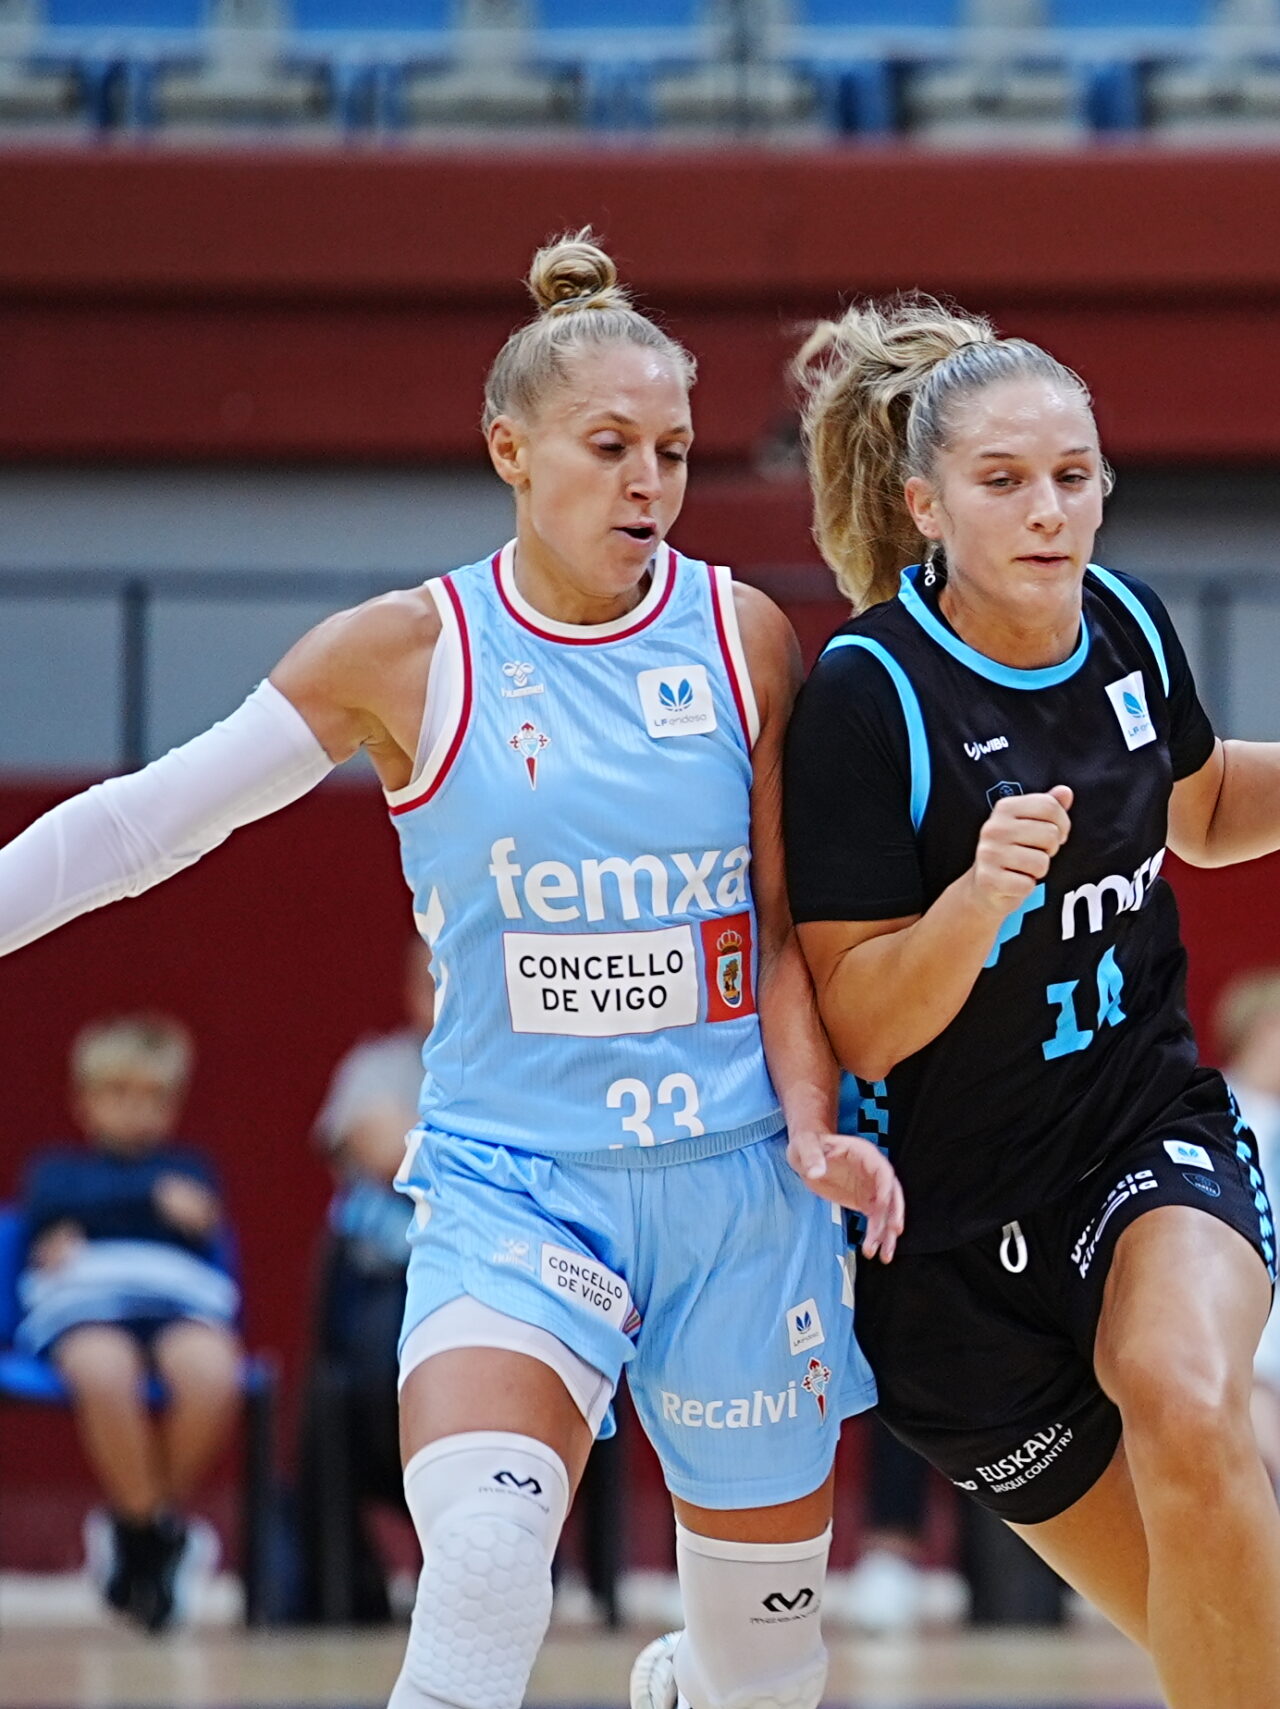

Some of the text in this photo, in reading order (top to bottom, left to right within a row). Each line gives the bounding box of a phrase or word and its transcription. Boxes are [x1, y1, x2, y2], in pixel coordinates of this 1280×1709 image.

[489, 837, 752, 923] femxa
[519, 950, 683, 979] CONCELLO
[542, 985, 667, 1012] DE VIGO
[606, 1072, 705, 1150] 33
[548, 1256, 623, 1299] CONCELLO
[557, 1275, 612, 1311] DE VIGO
[661, 1380, 798, 1429] Recalvi
[1024, 1428, 1073, 1479] COUNTRY
